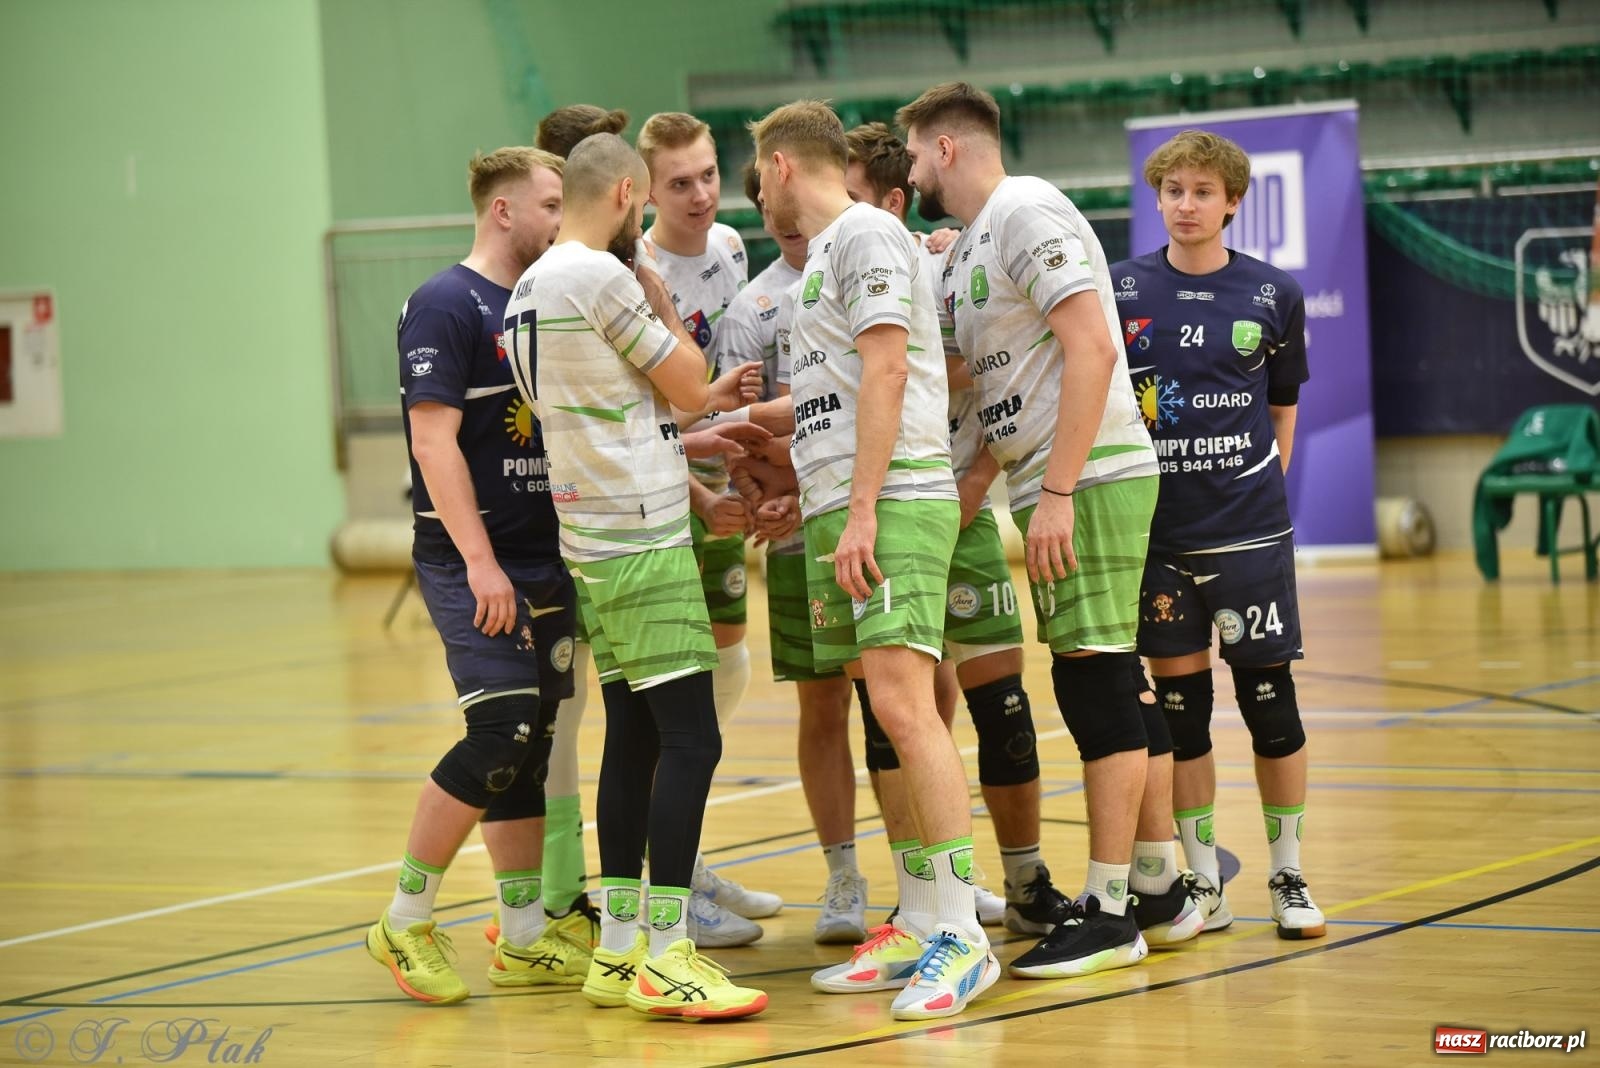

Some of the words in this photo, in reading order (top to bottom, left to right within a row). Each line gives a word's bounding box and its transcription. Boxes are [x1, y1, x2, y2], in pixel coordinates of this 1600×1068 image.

[1041, 238, 1063, 249] SPORT
[870, 267, 893, 276] SPORT
[1180, 324, 1205, 347] 24
[407, 350, 417, 358] MK
[417, 347, 439, 356] SPORT
[793, 350, 827, 376] GUARD
[795, 393, 842, 424] CIEPŁA
[1192, 392, 1253, 408] GUARD
[660, 422, 679, 440] PO
[808, 418, 831, 435] 146
[995, 422, 1017, 440] 146
[1153, 438, 1190, 457] MPY
[1194, 432, 1252, 456] CIEPŁA
[1160, 461, 1178, 473] 05
[1183, 459, 1213, 473] 944
[1217, 455, 1244, 469] 146
[878, 578, 891, 614] 1
[987, 581, 1015, 617] 10
[1247, 601, 1284, 640] 24
